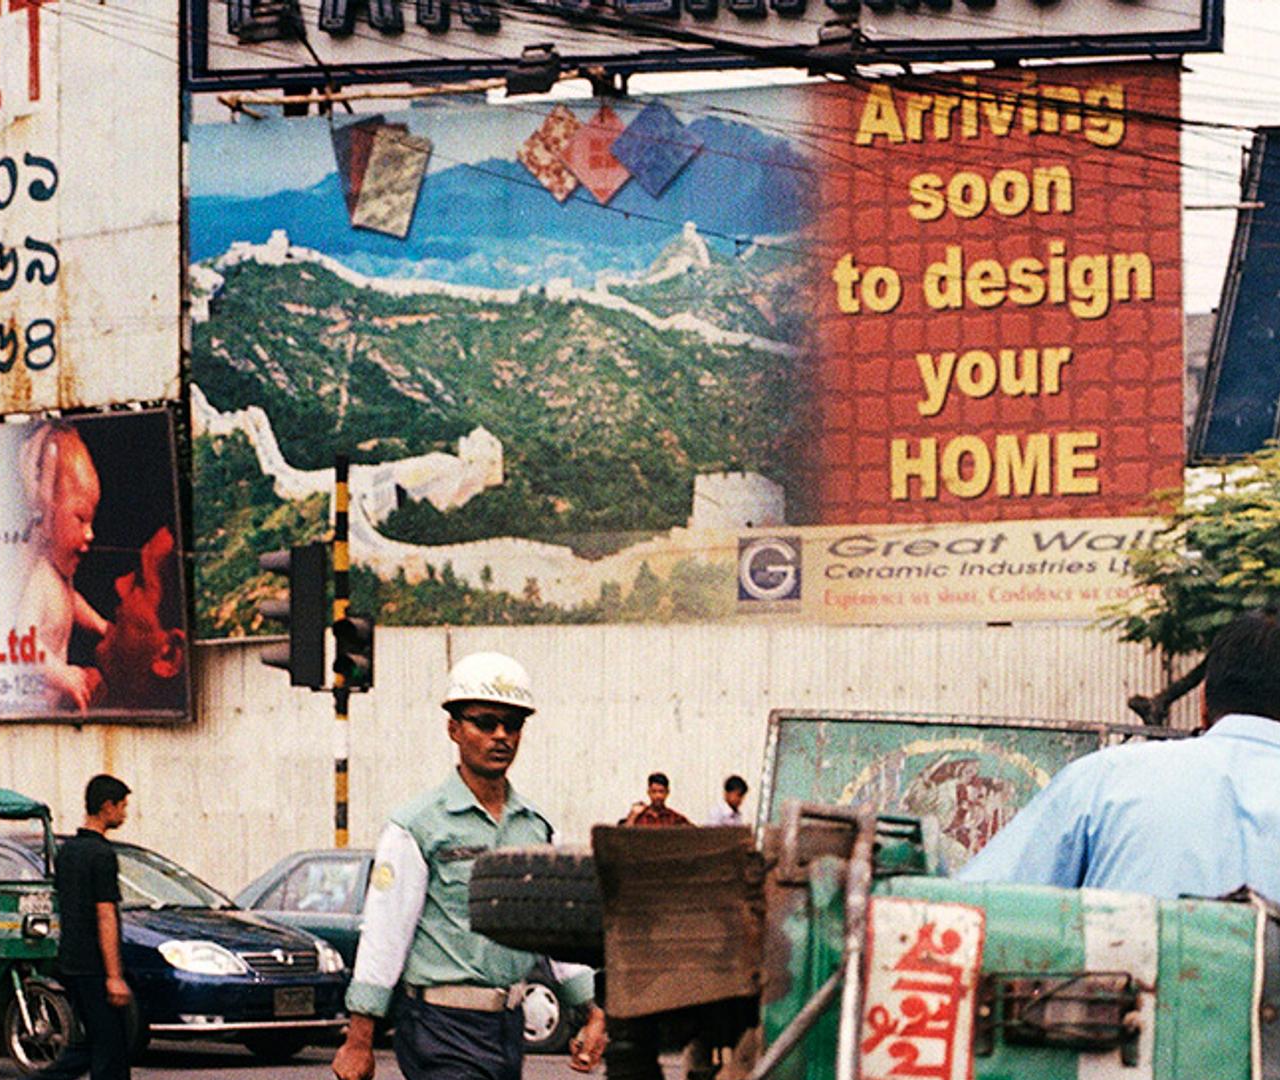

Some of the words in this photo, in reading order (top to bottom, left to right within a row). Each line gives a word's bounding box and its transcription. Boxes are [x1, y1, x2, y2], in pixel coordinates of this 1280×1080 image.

[855, 72, 1126, 147] Arriving
[908, 164, 1073, 221] soon
[832, 252, 903, 314] to
[924, 241, 1154, 319] design
[916, 345, 1073, 416] your
[891, 431, 1100, 500] HOME
[825, 561, 950, 581] Ceramic
[960, 558, 1097, 579] Industries
[1110, 556, 1132, 575] Lt
[828, 532, 1009, 558] Great
